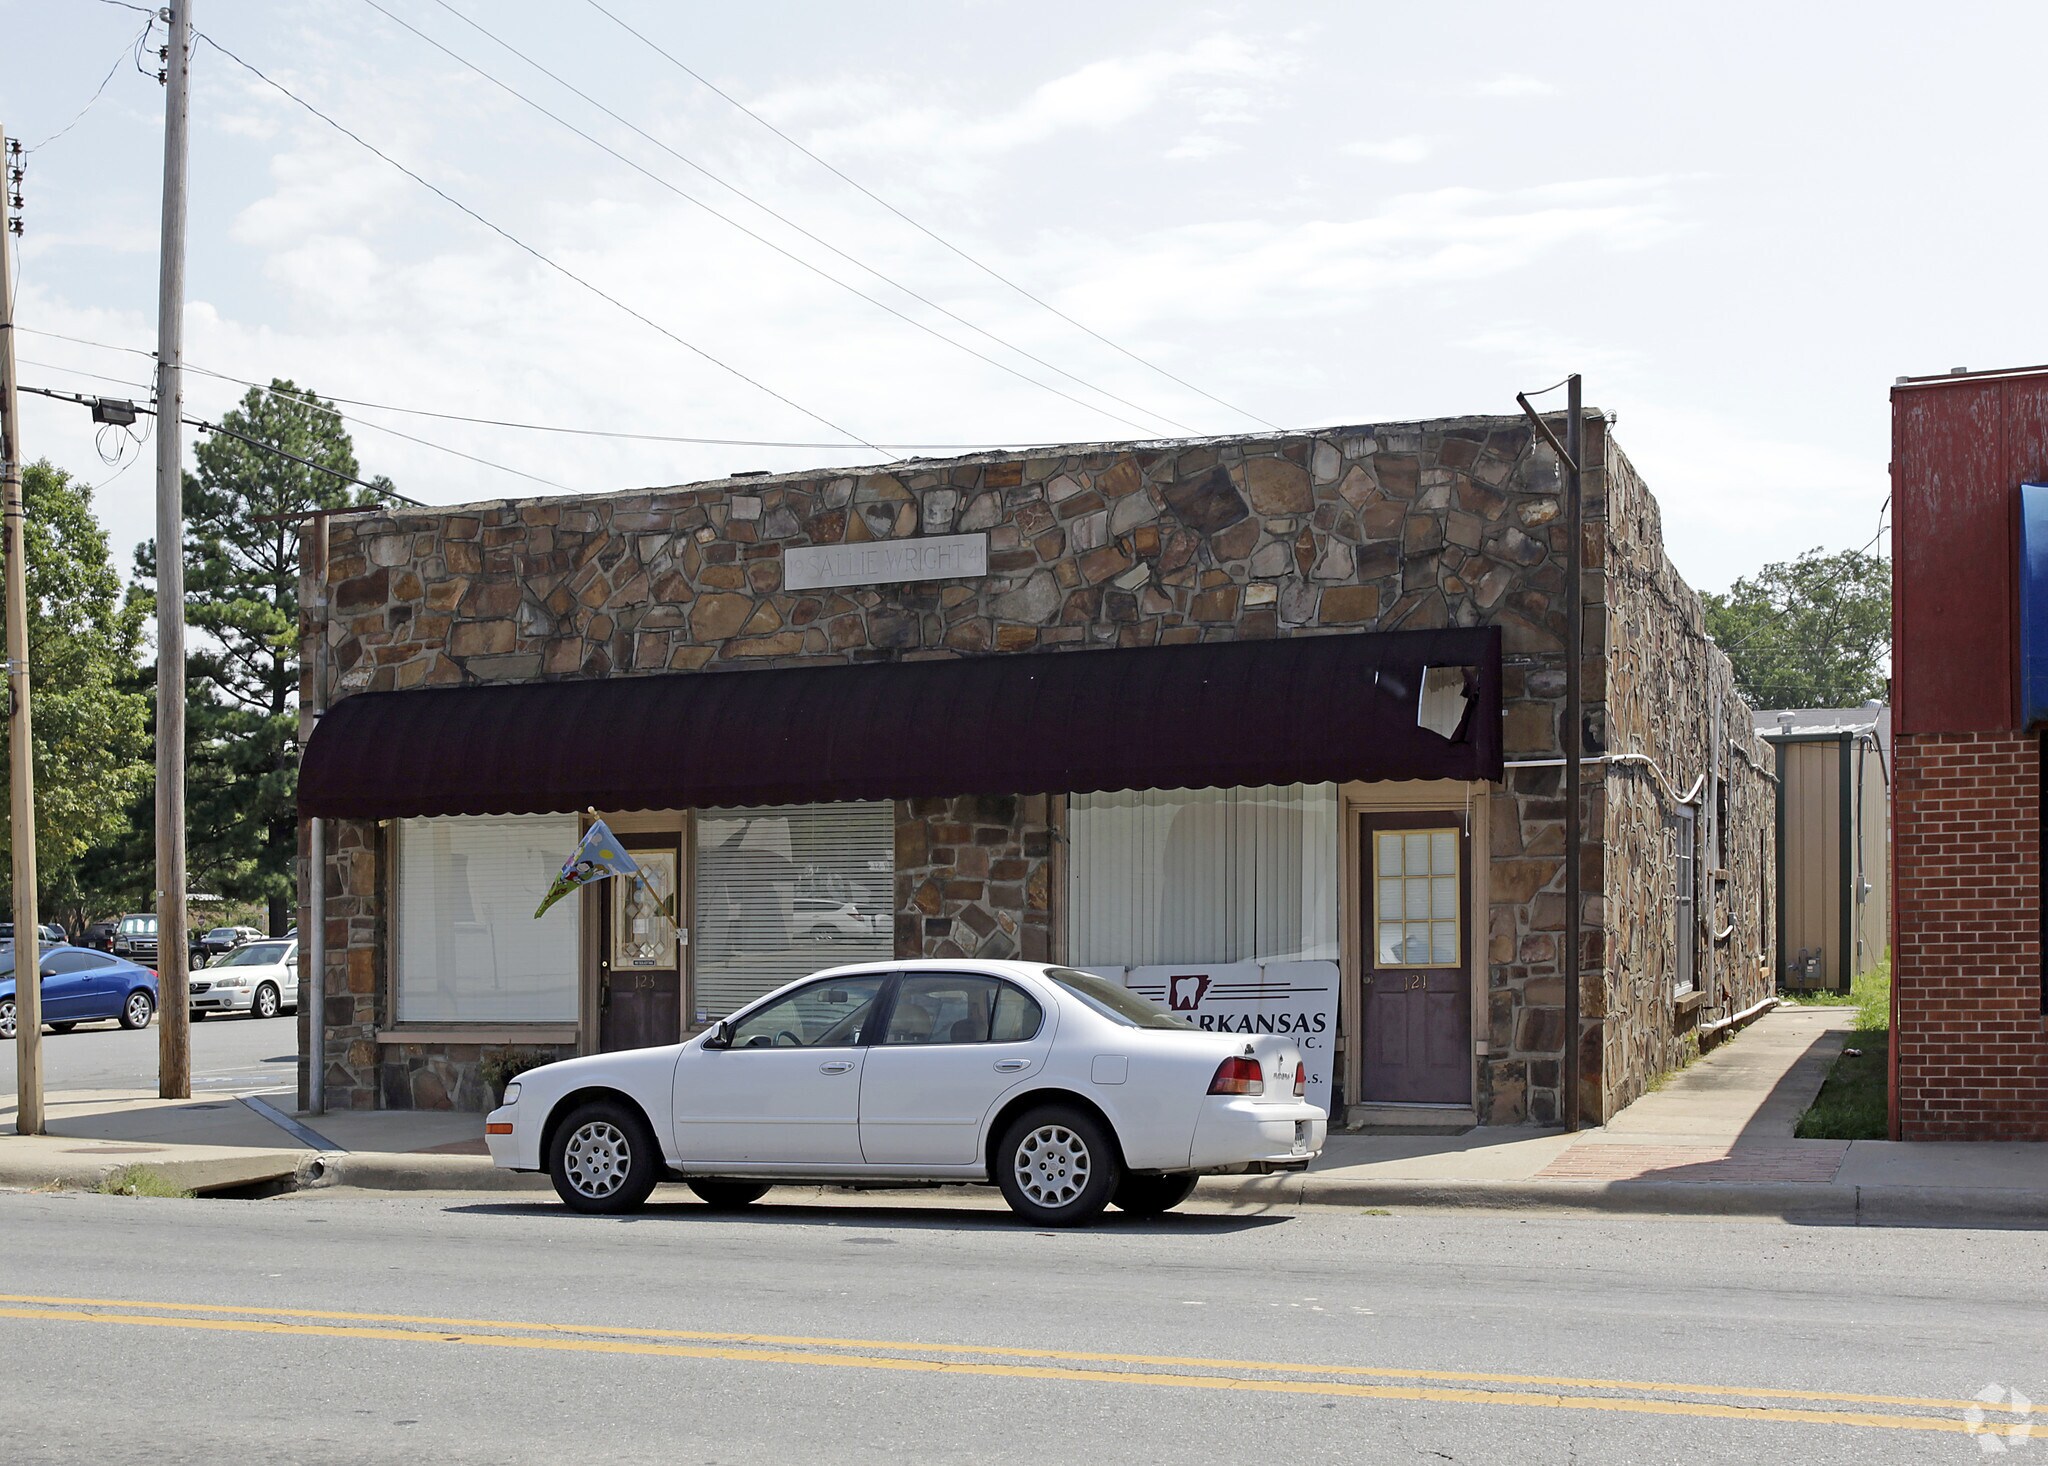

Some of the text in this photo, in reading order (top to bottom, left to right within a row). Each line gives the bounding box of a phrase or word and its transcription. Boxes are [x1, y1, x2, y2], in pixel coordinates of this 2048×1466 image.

[808, 551, 879, 578] SALLIE
[885, 544, 965, 573] WRIGHT
[635, 975, 655, 989] 123
[1404, 975, 1426, 991] 121
[1304, 1073, 1323, 1084] .S.
